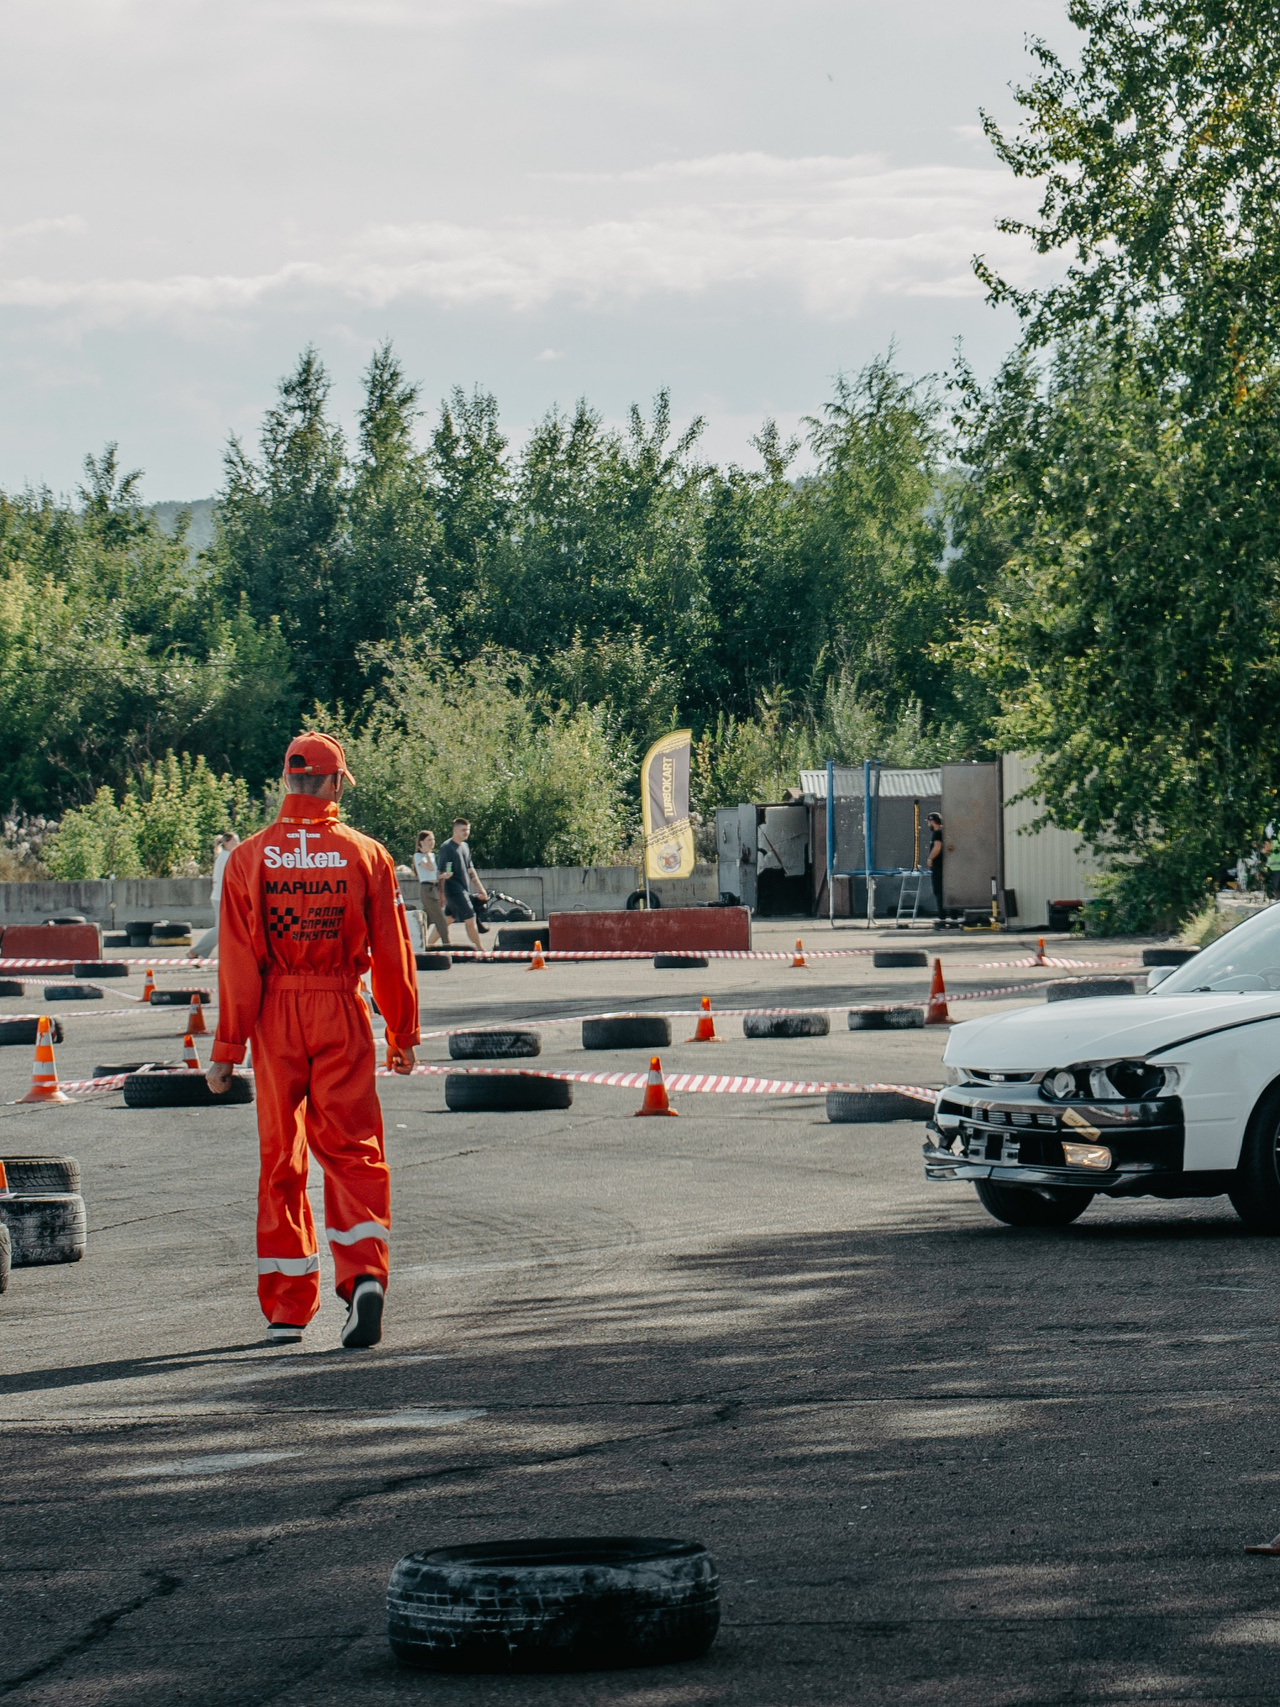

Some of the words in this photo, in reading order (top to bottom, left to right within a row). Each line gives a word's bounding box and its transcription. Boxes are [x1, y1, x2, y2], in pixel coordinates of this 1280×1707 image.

[662, 756, 674, 818] TURBOKART
[263, 829, 348, 869] Seiken
[265, 880, 347, 894] МАРШАЛ
[307, 906, 345, 918] РАЛЛИ
[300, 918, 343, 930] СПРИНТ
[291, 929, 340, 941] ИРКУТСК
